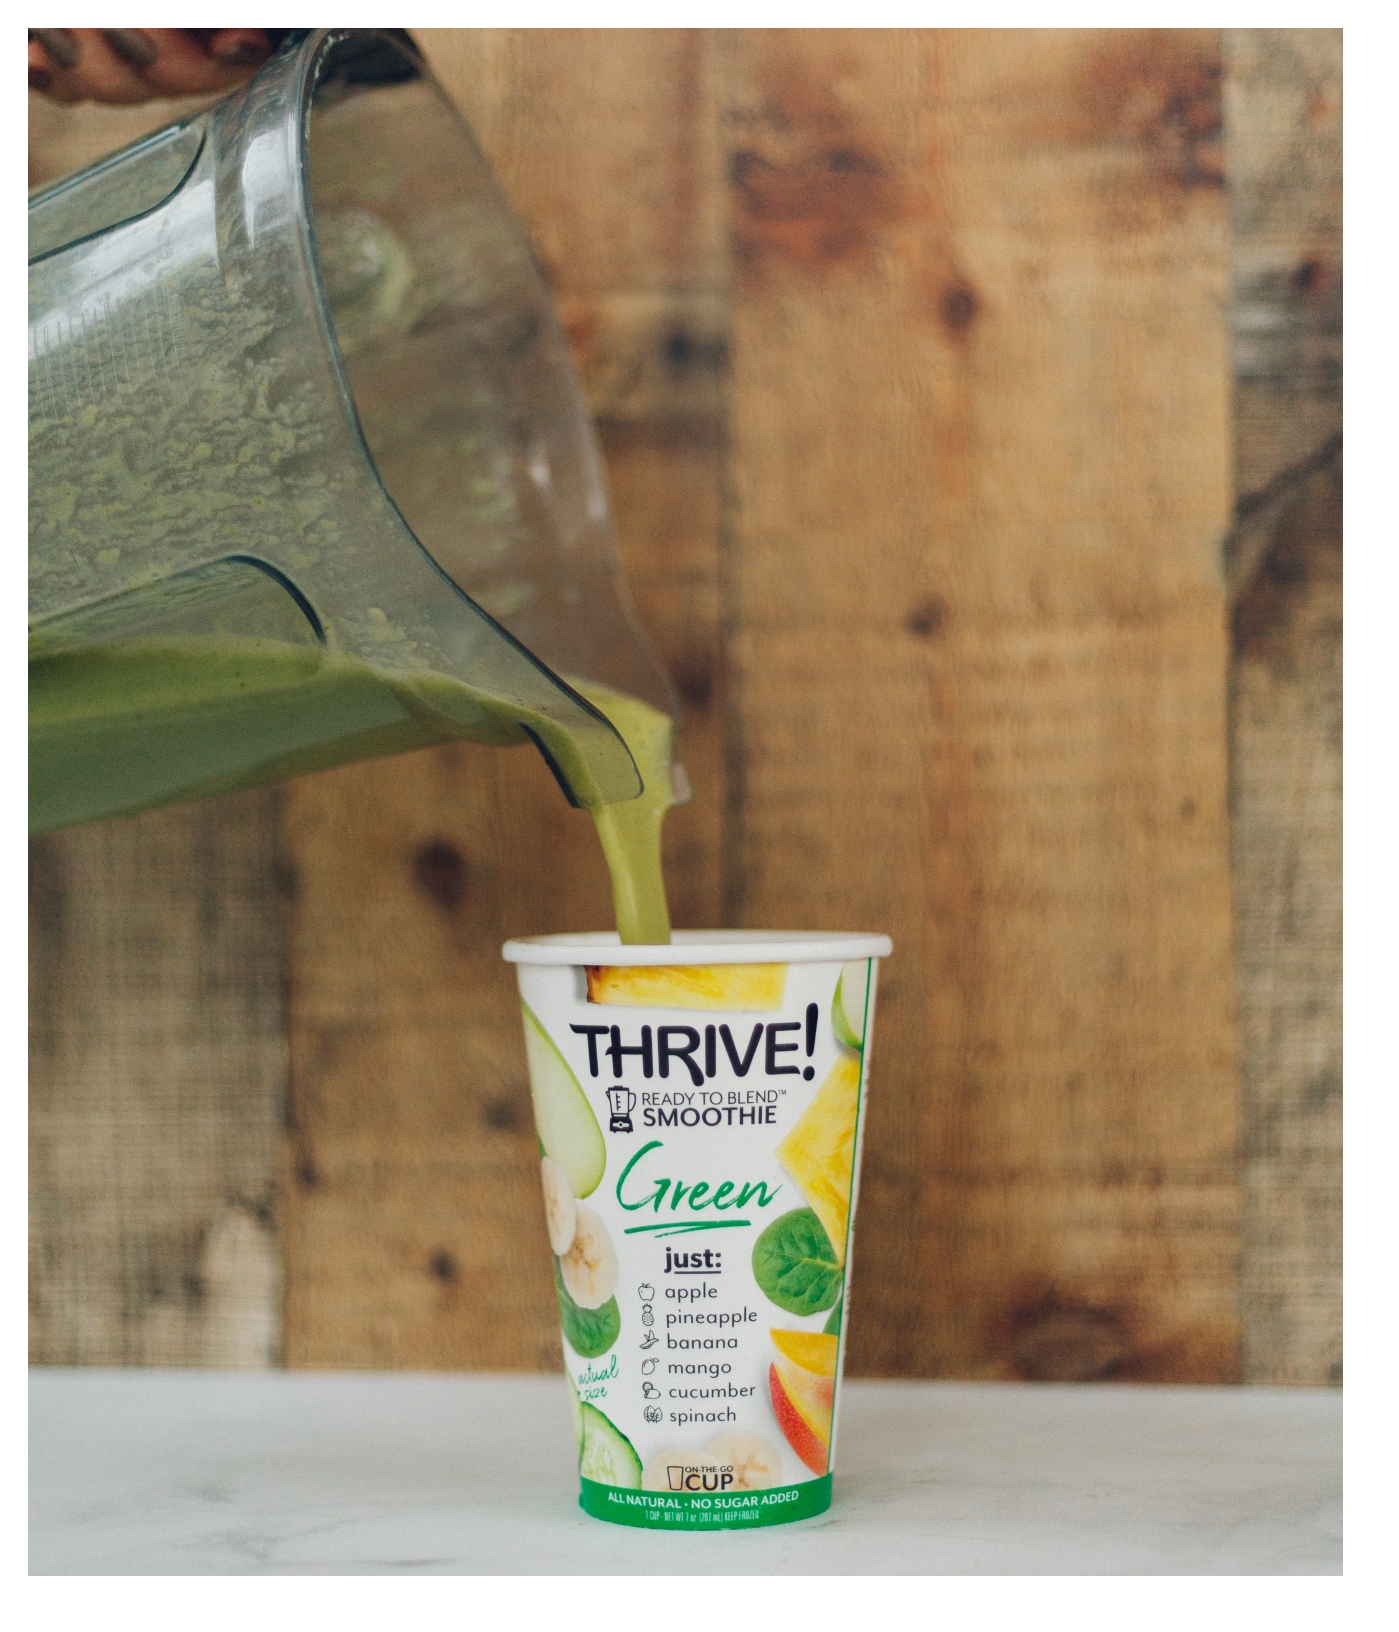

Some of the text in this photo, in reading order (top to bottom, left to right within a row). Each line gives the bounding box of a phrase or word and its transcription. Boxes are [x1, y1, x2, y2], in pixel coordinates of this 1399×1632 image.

[569, 1002, 819, 1087] THRIVE!
[641, 1092, 695, 1106] READY
[699, 1092, 723, 1105] TO
[643, 1105, 777, 1127] SMOOTHIE
[616, 1140, 783, 1213] Green
[663, 1246, 722, 1274] just:
[664, 1281, 718, 1303] apple
[666, 1306, 758, 1328] pineapple
[667, 1332, 738, 1349] banana
[668, 1363, 732, 1379] mango
[668, 1381, 756, 1399] cucumber
[669, 1405, 737, 1427] spinach
[685, 1465, 734, 1473] ON-THE-GO
[685, 1473, 734, 1491] CUP
[608, 1490, 799, 1509] ALL NATURAL NO SUGAR ADDED
